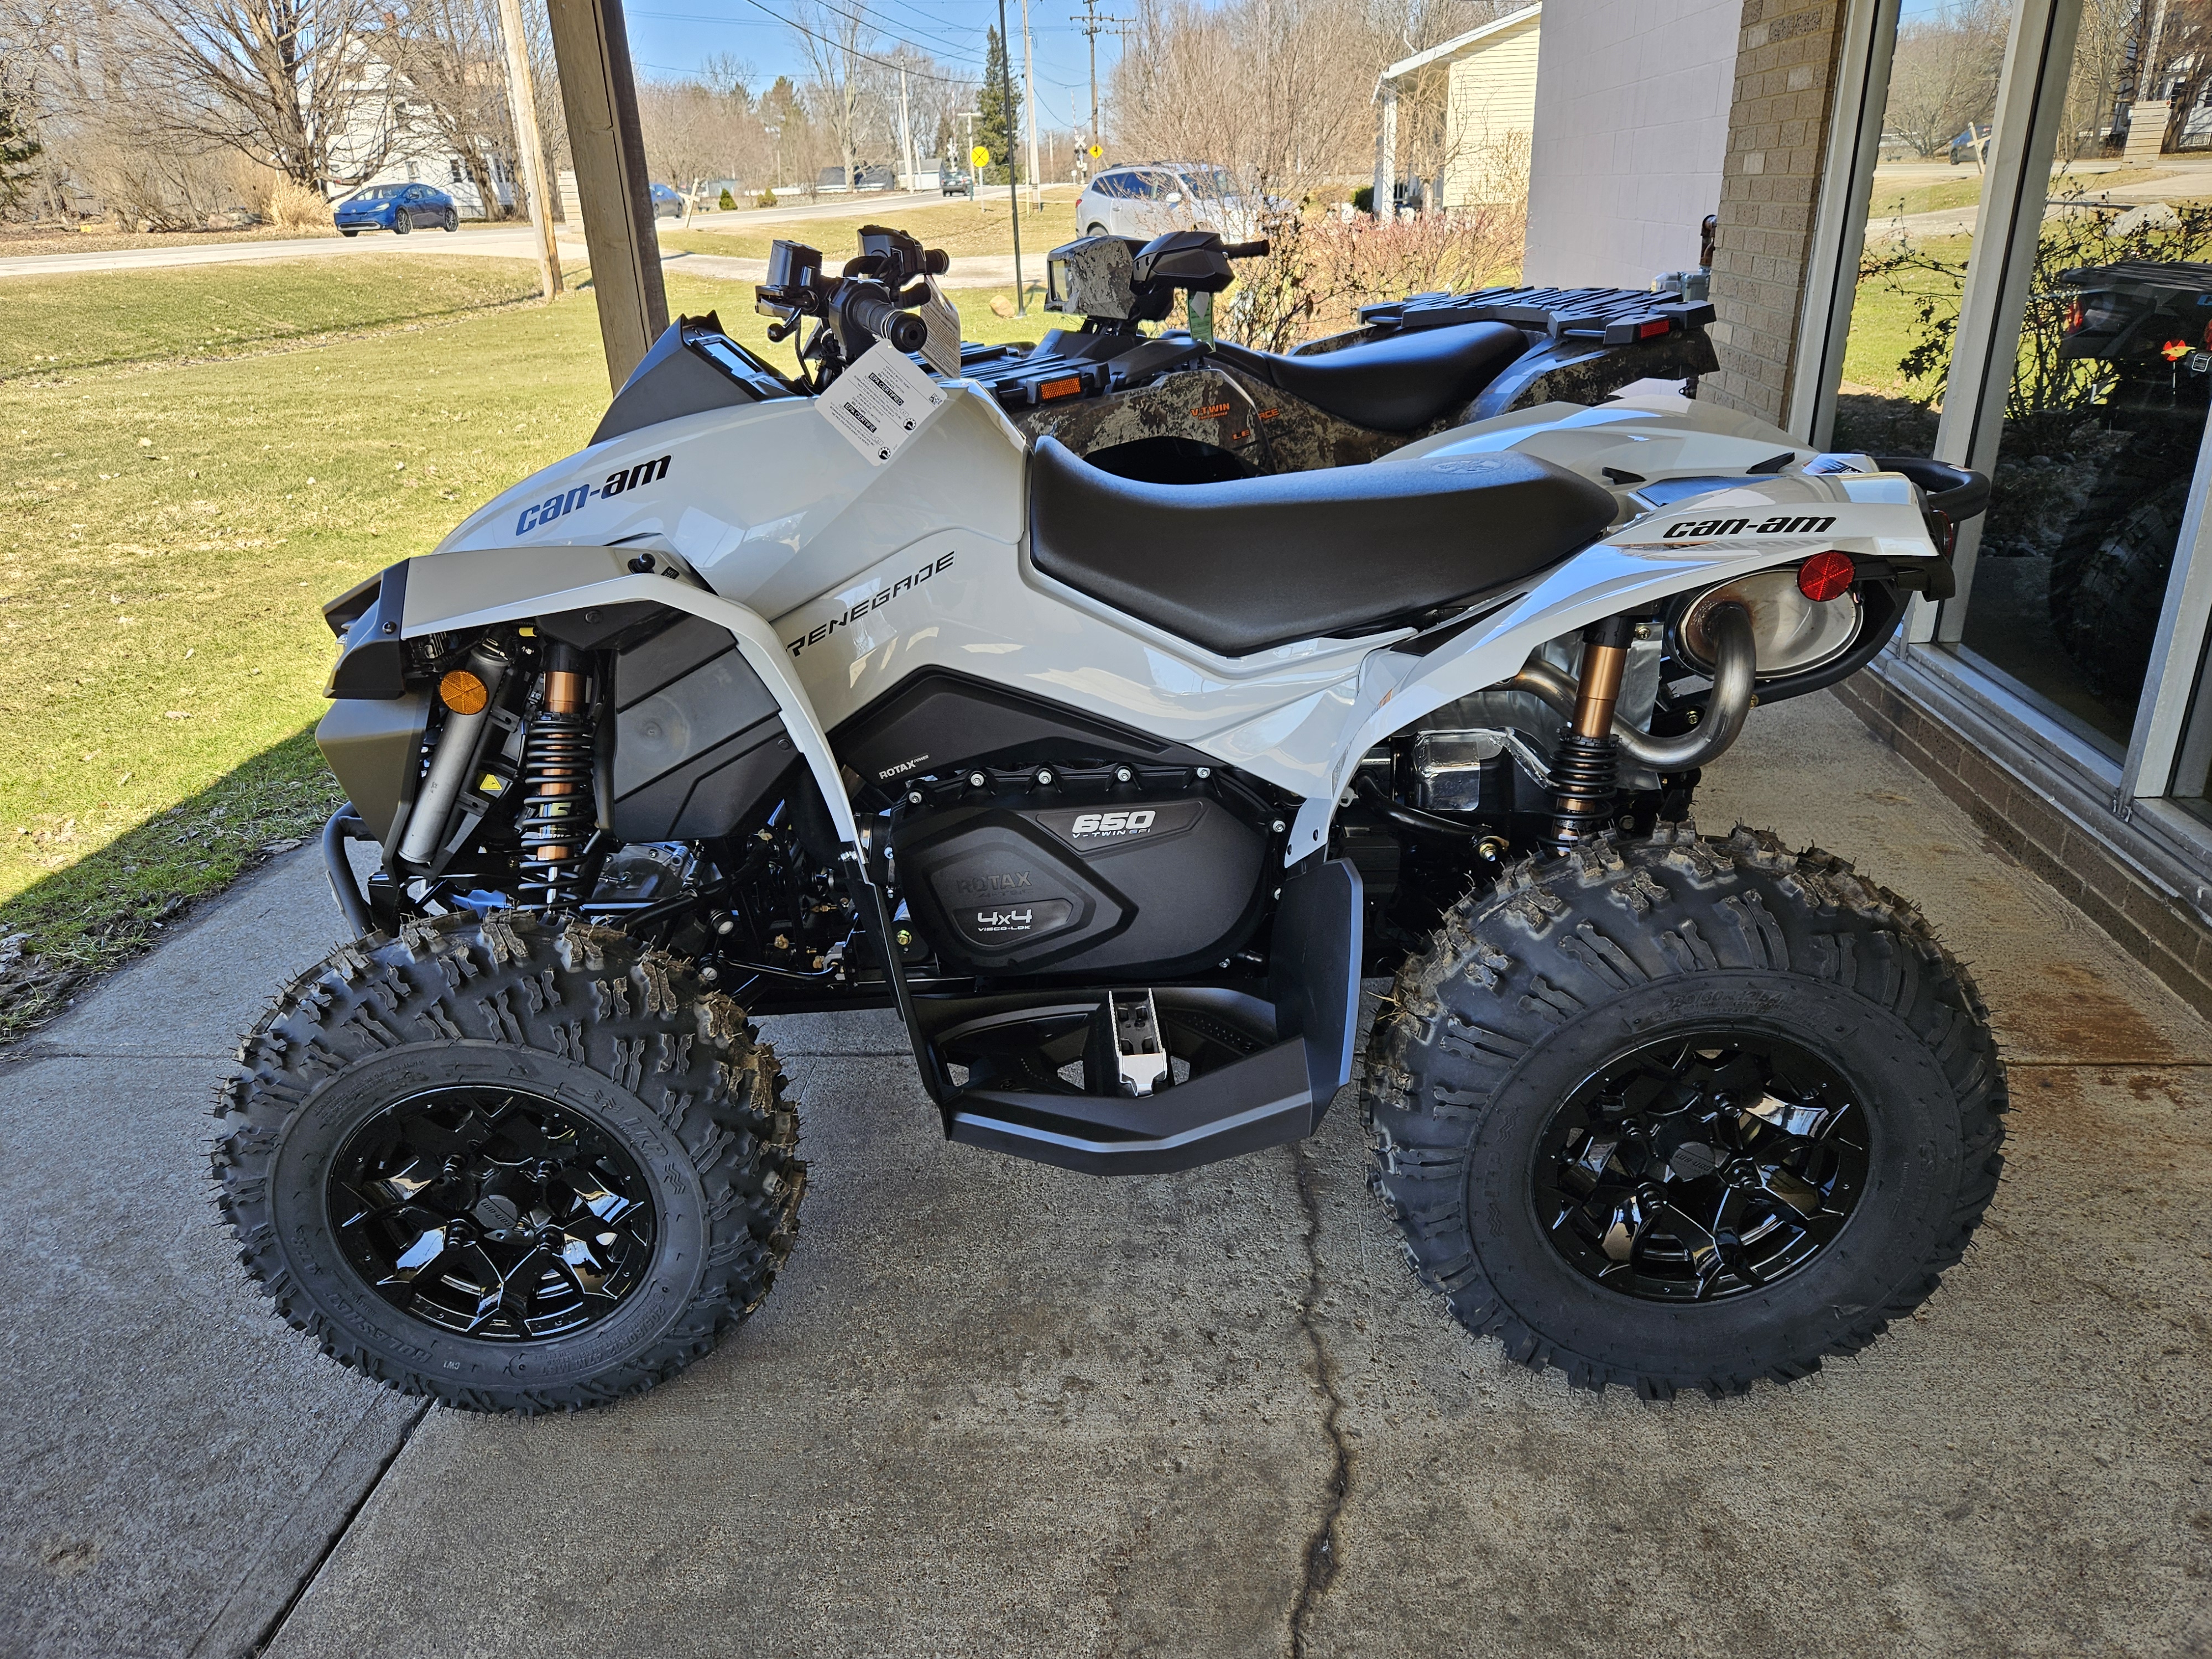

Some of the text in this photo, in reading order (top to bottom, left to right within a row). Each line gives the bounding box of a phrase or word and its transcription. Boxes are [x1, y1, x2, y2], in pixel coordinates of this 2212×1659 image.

[869, 373, 880, 384] EPA
[878, 381, 904, 405] CERTIFIED
[844, 403, 856, 414] EPA
[853, 411, 876, 432] CERTIFIÉ
[1233, 429, 1250, 440] LE
[515, 455, 671, 536] can-am
[1662, 517, 1837, 538] can-am
[785, 550, 955, 657] RENEGADE
[878, 754, 929, 780] ROTAX POWER
[1072, 811, 1156, 833] 650
[956, 870, 1032, 894] ROTAX
[977, 909, 1032, 925] 4x4
[622, 1117, 668, 1157] ITP
[1484, 1150, 1503, 1198] ITP
[1675, 1154, 1711, 1171] can-am
[480, 1202, 513, 1227] can-am
[322, 1291, 432, 1363] HOLESHOT
[605, 1305, 666, 1357] 205/80R12
[574, 1353, 602, 1370] 47M
